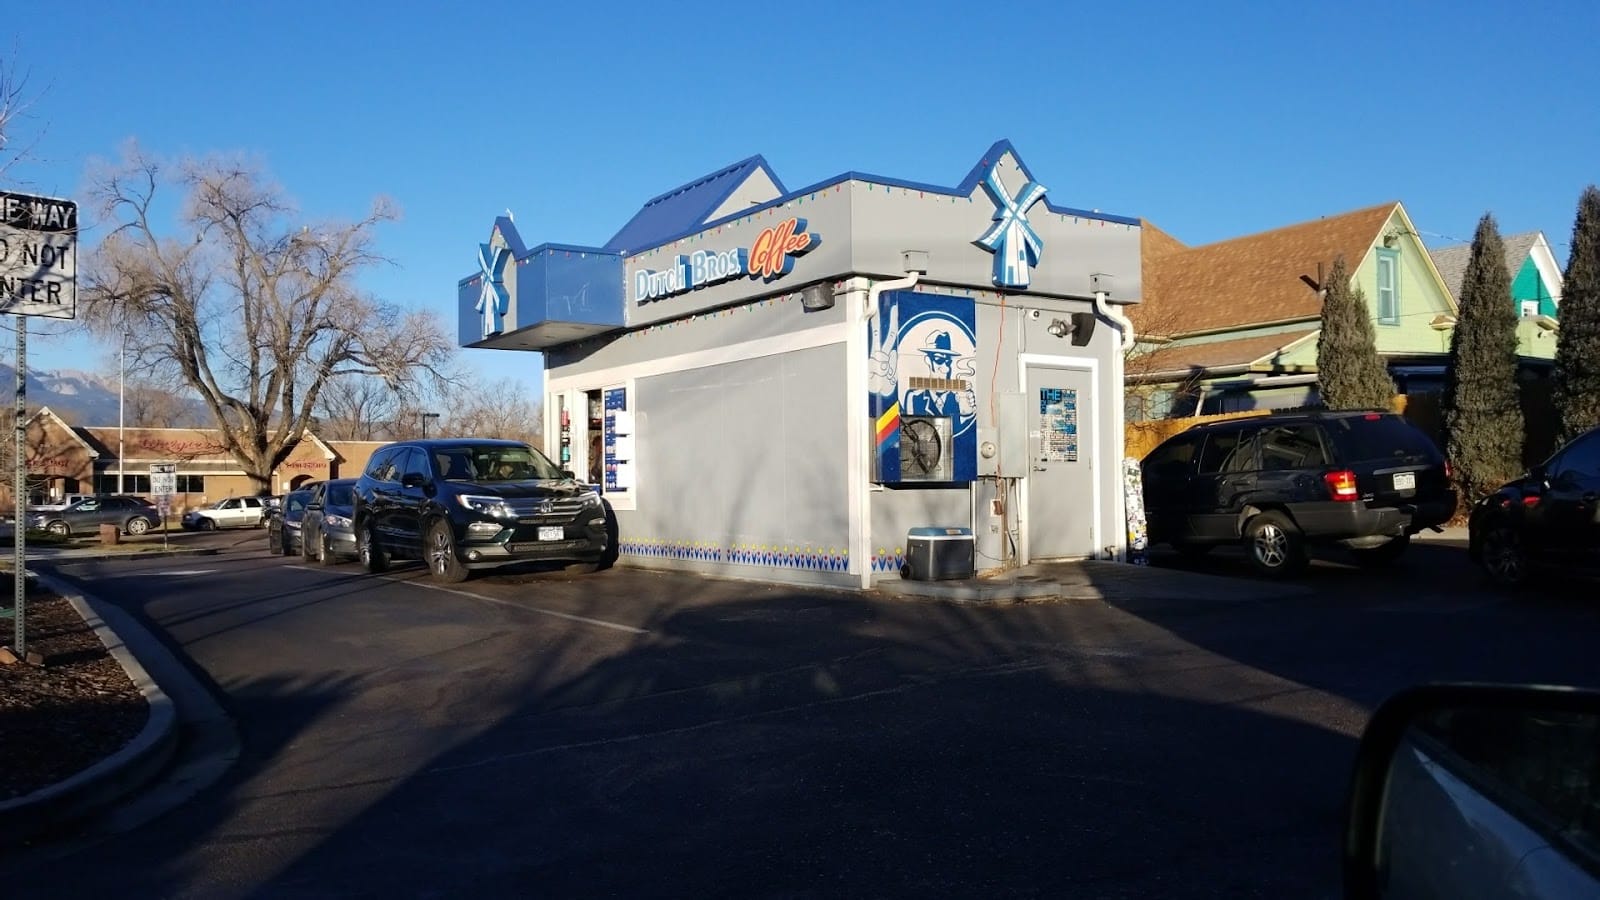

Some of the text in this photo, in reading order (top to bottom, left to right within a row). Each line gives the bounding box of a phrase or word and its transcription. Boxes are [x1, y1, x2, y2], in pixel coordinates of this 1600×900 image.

[30, 202, 74, 229] WAY
[23, 243, 69, 270] NOT
[748, 217, 812, 277] Coffee
[1040, 389, 1061, 401] THE
